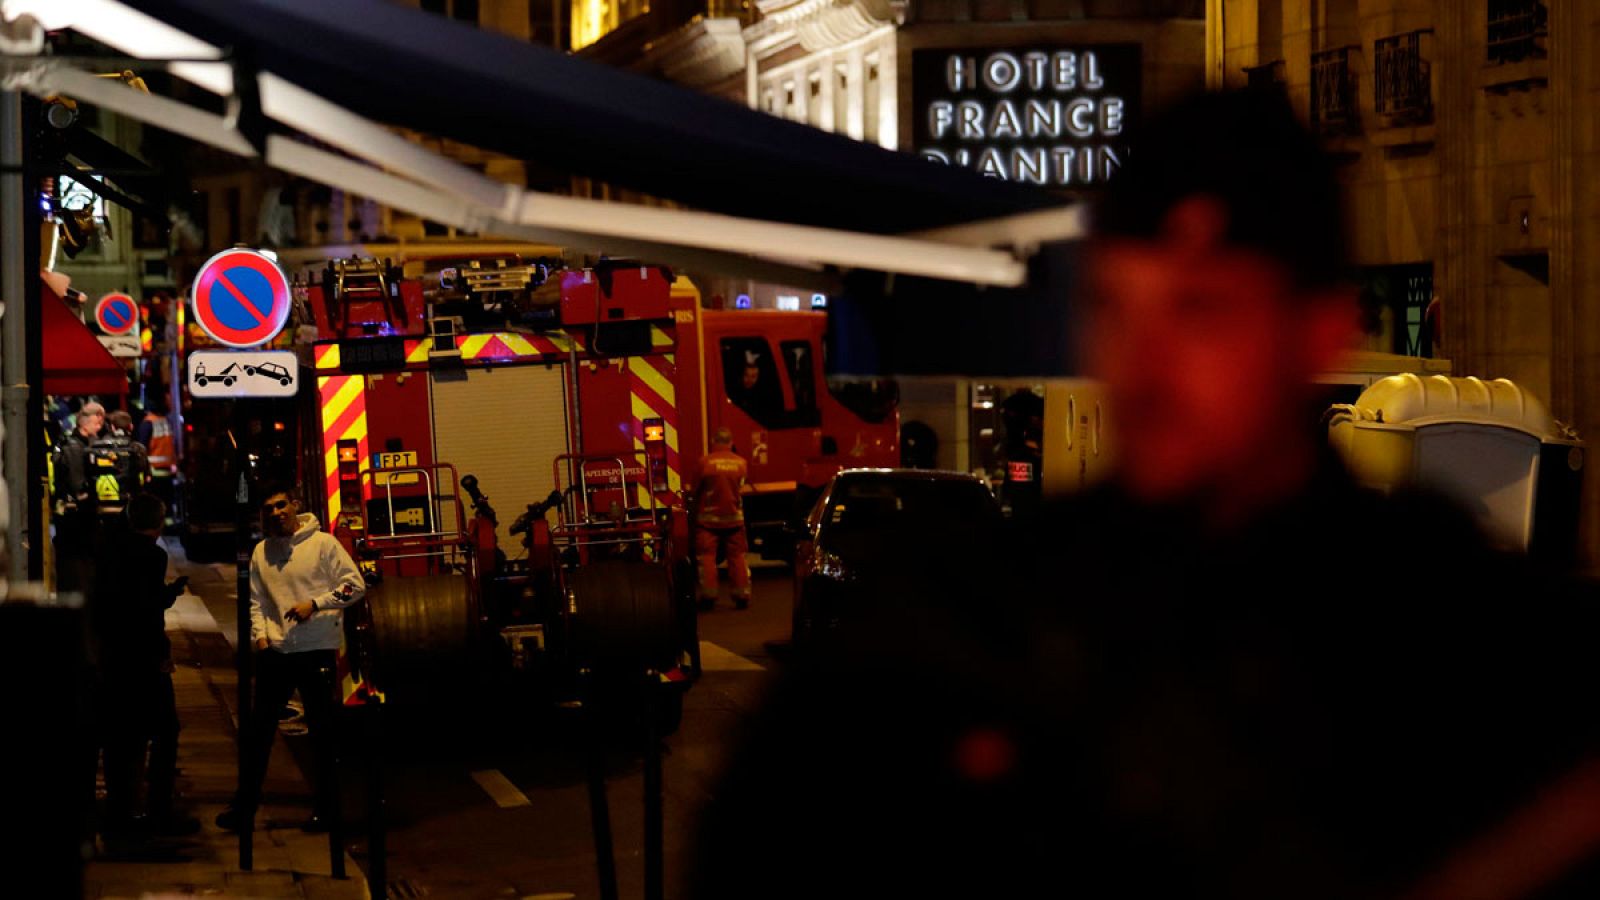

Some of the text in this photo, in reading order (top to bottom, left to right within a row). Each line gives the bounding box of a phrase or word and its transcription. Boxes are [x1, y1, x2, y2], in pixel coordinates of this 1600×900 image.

[946, 50, 1104, 92] HOTEL
[928, 97, 1124, 139] FRANCE
[383, 453, 411, 468] FPT
